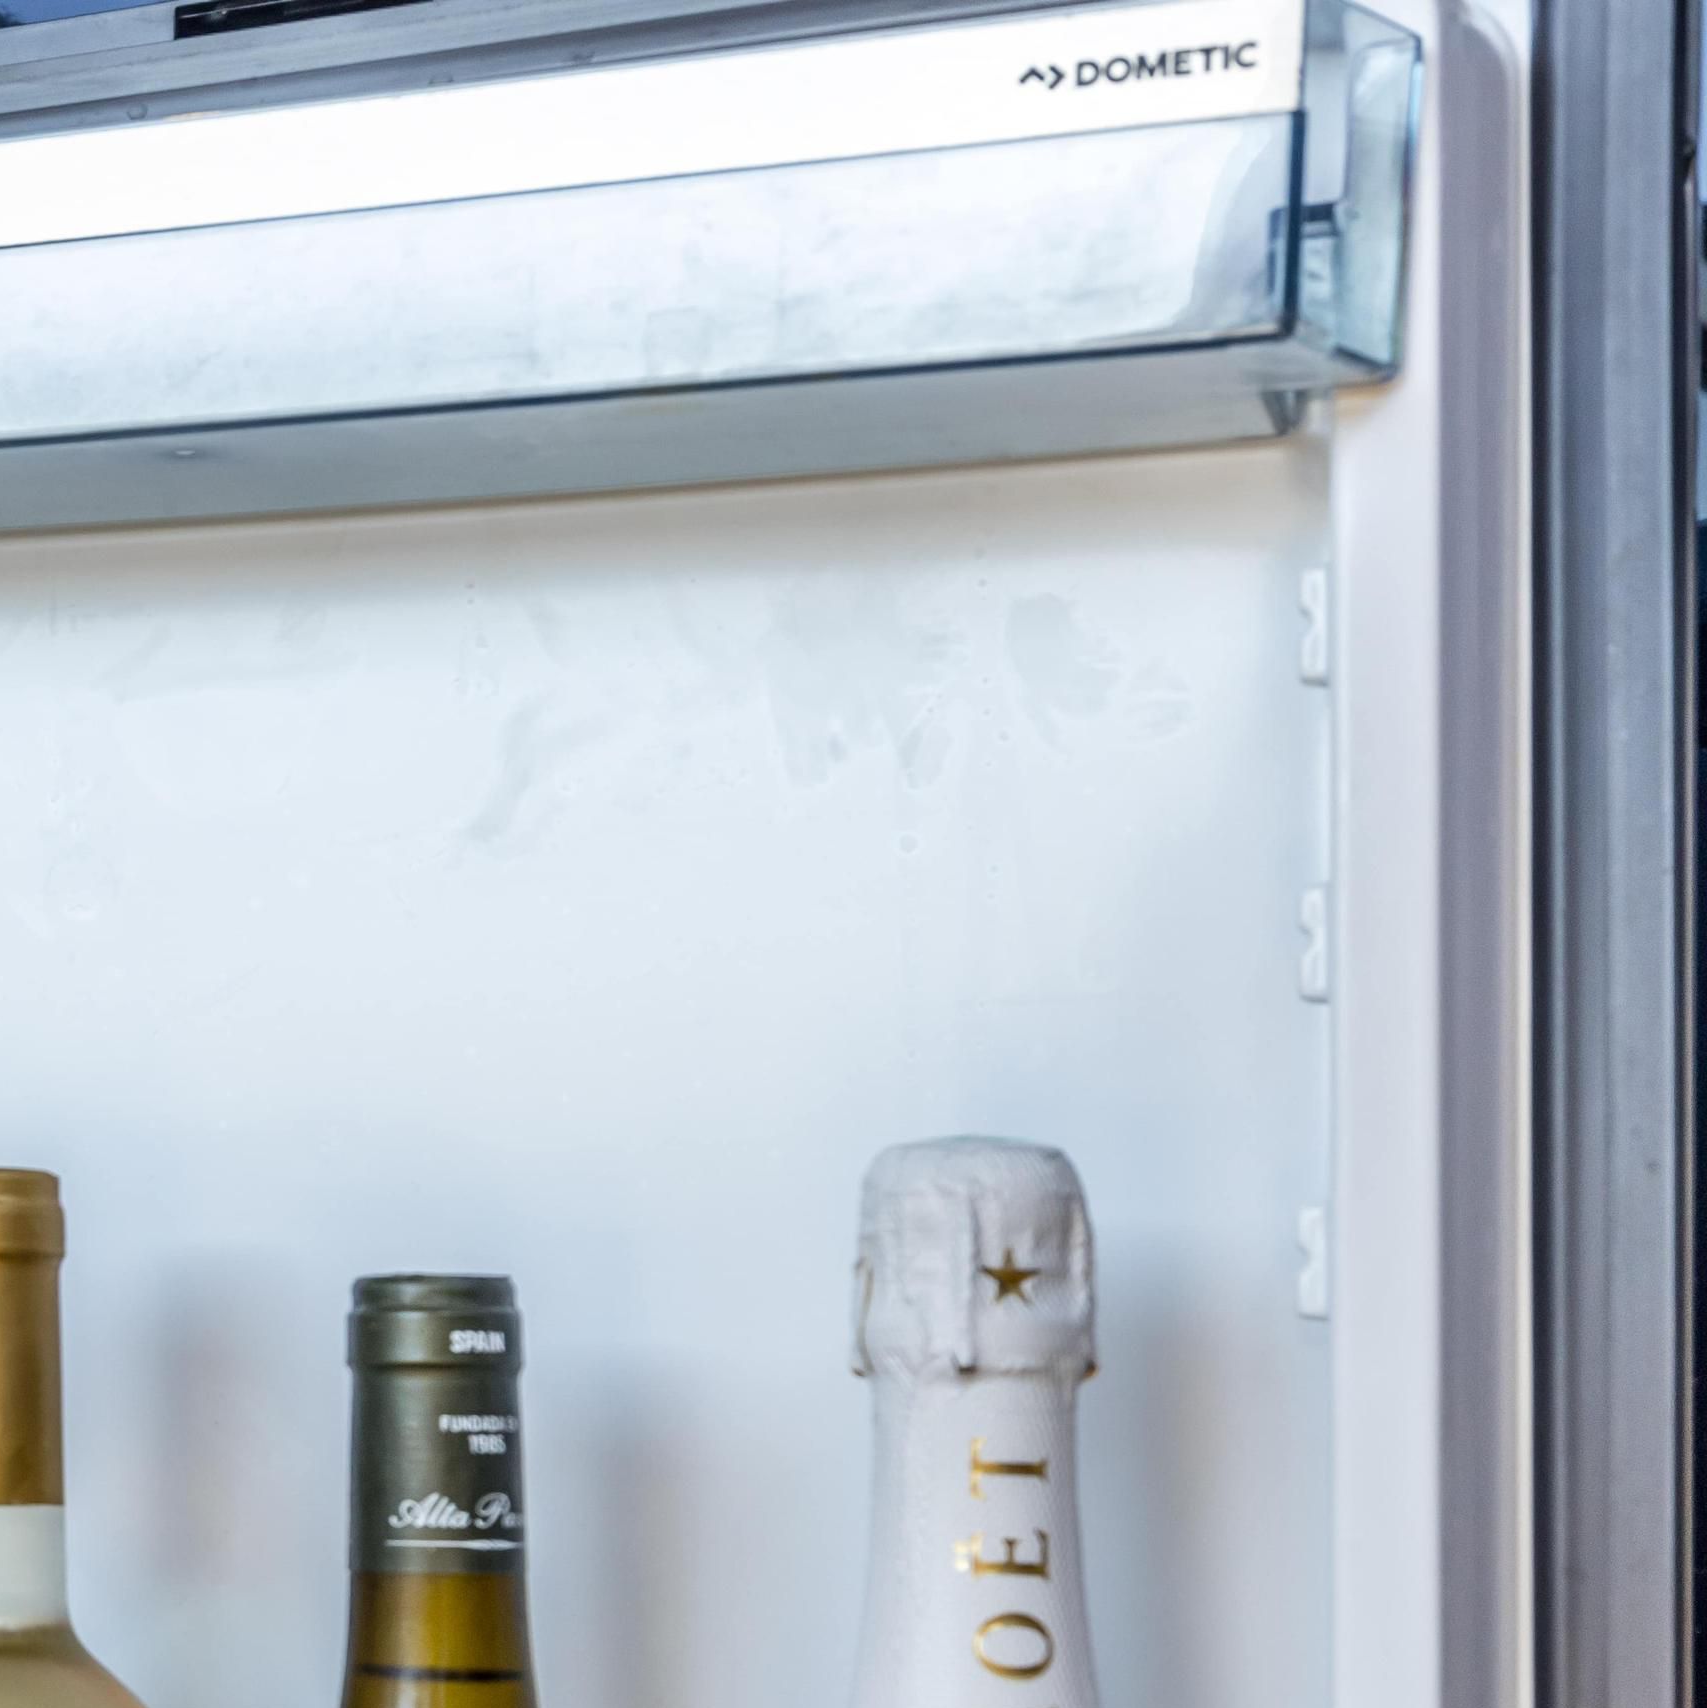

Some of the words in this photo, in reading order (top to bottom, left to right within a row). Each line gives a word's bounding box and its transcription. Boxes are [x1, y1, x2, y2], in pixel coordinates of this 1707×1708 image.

[1076, 42, 1259, 87] DOMETIC
[449, 1330, 506, 1354] SPAIN
[388, 1492, 472, 1530] Alta
